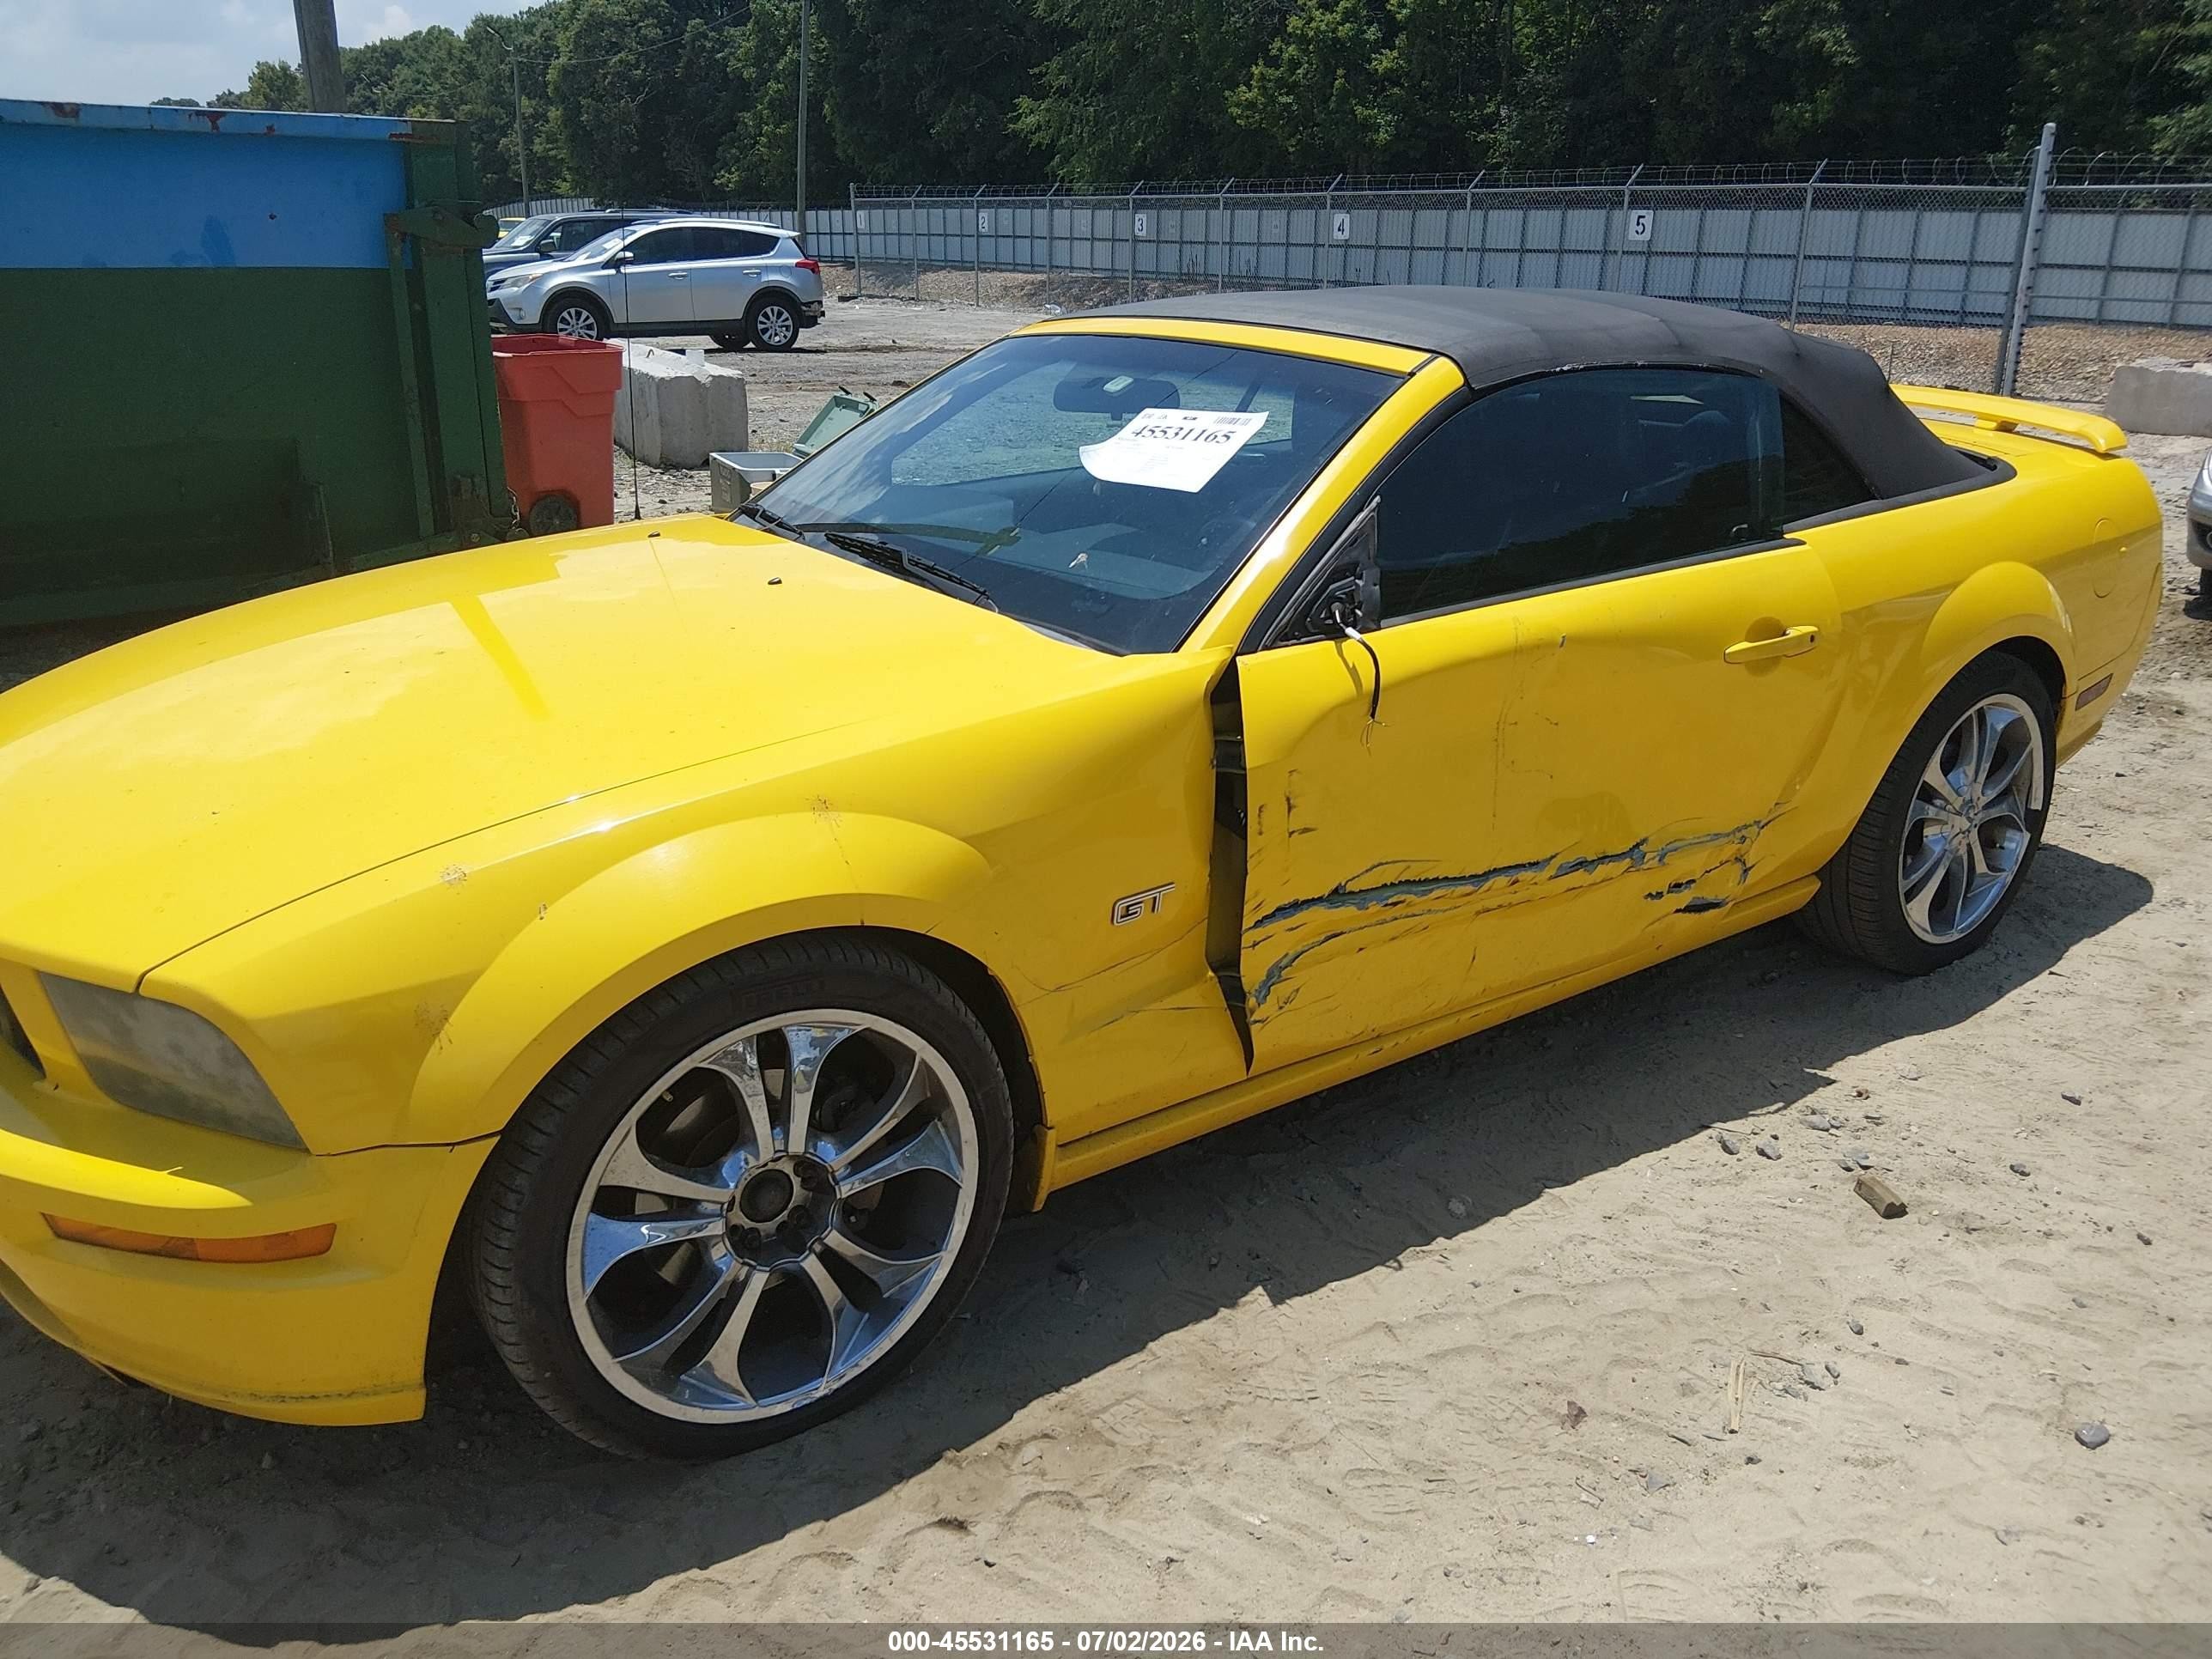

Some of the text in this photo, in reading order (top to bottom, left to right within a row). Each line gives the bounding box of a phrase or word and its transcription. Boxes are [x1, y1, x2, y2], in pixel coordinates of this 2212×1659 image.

[981, 216, 986, 229] 2
[1137, 217, 1144, 232] 3
[1337, 218, 1345, 235] 4
[1635, 215, 1646, 234] 5
[1132, 424, 1237, 444] 45531165
[1110, 881, 1176, 926] GT
